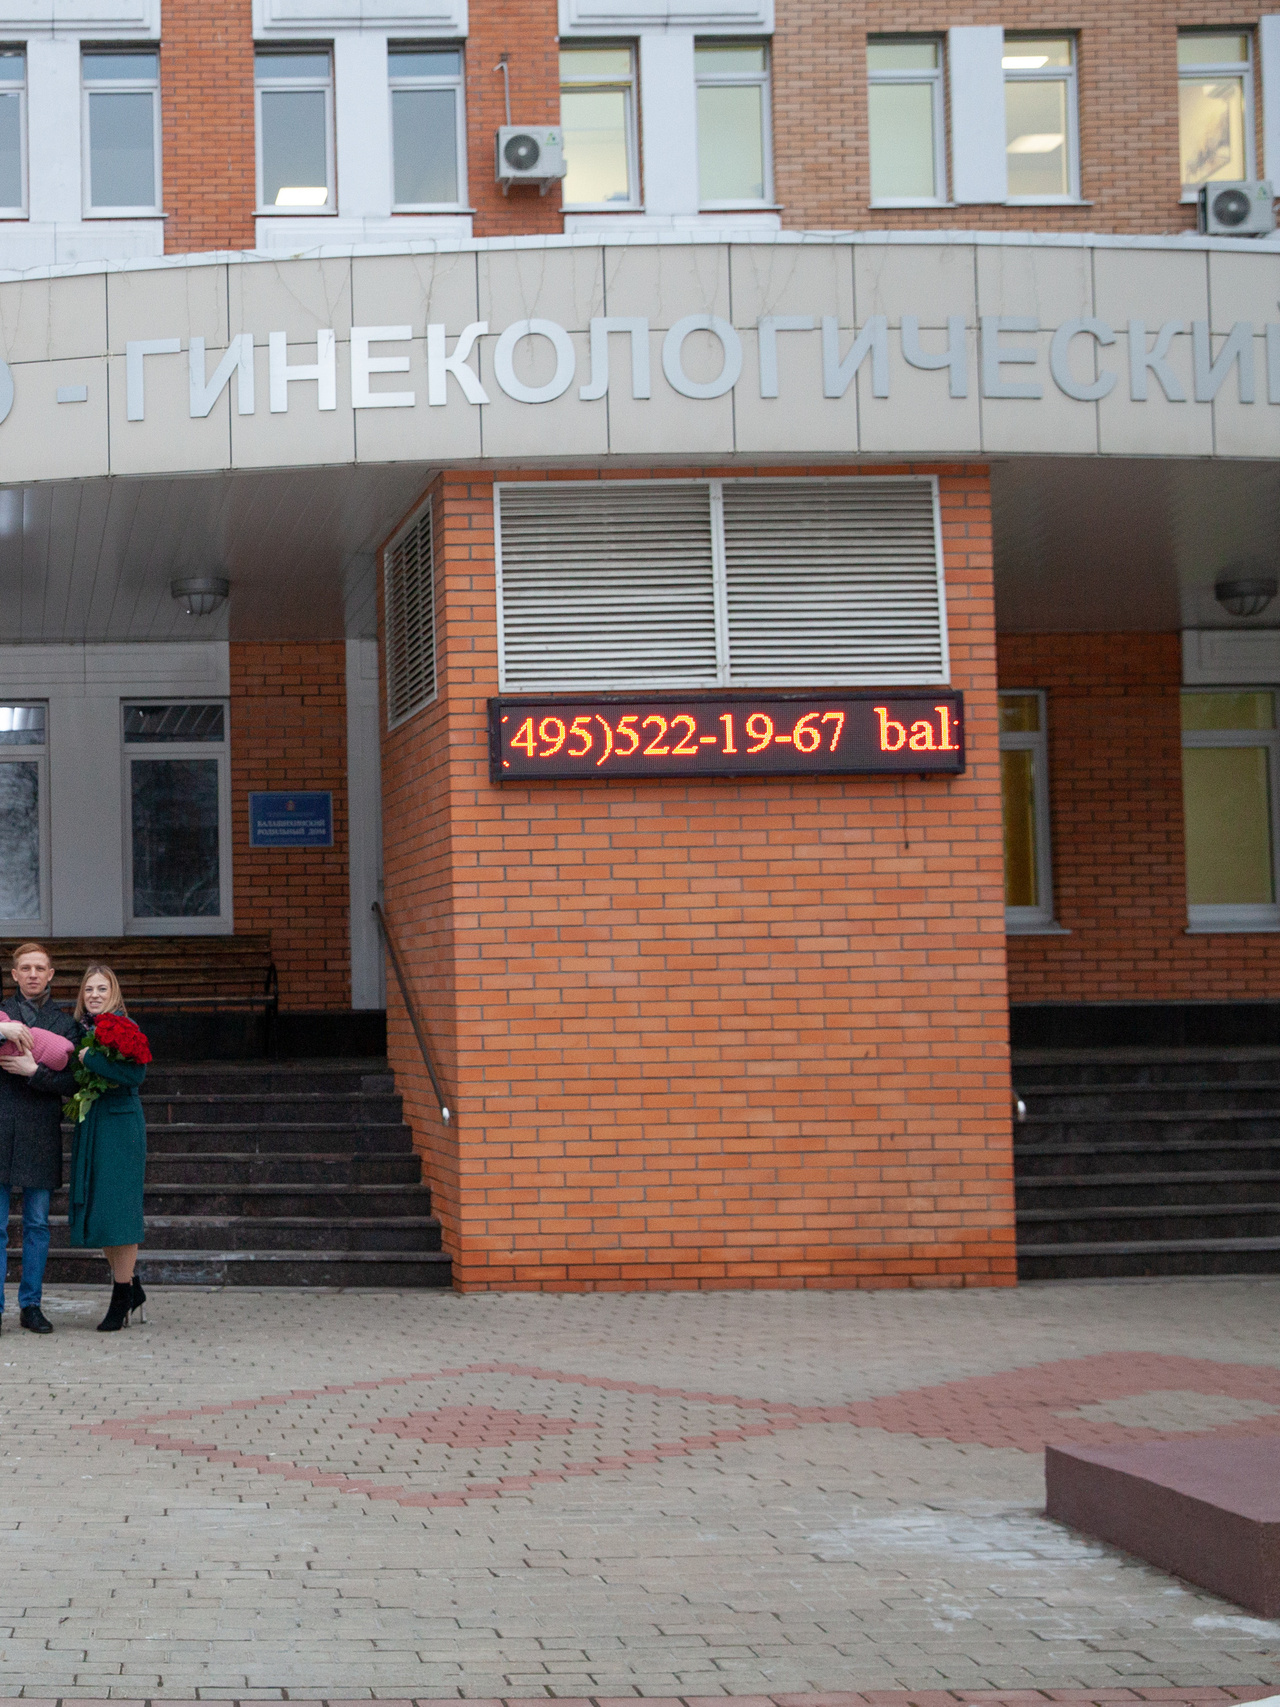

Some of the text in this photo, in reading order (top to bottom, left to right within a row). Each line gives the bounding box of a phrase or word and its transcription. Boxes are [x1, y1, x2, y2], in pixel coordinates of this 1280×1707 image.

[125, 314, 1280, 422] ГИНЕКОЛОГИЧЕСКИ
[501, 705, 961, 767] 495)522-19-67 bal
[257, 828, 326, 836] РОДИЛЬНЫЙ ДОМ
